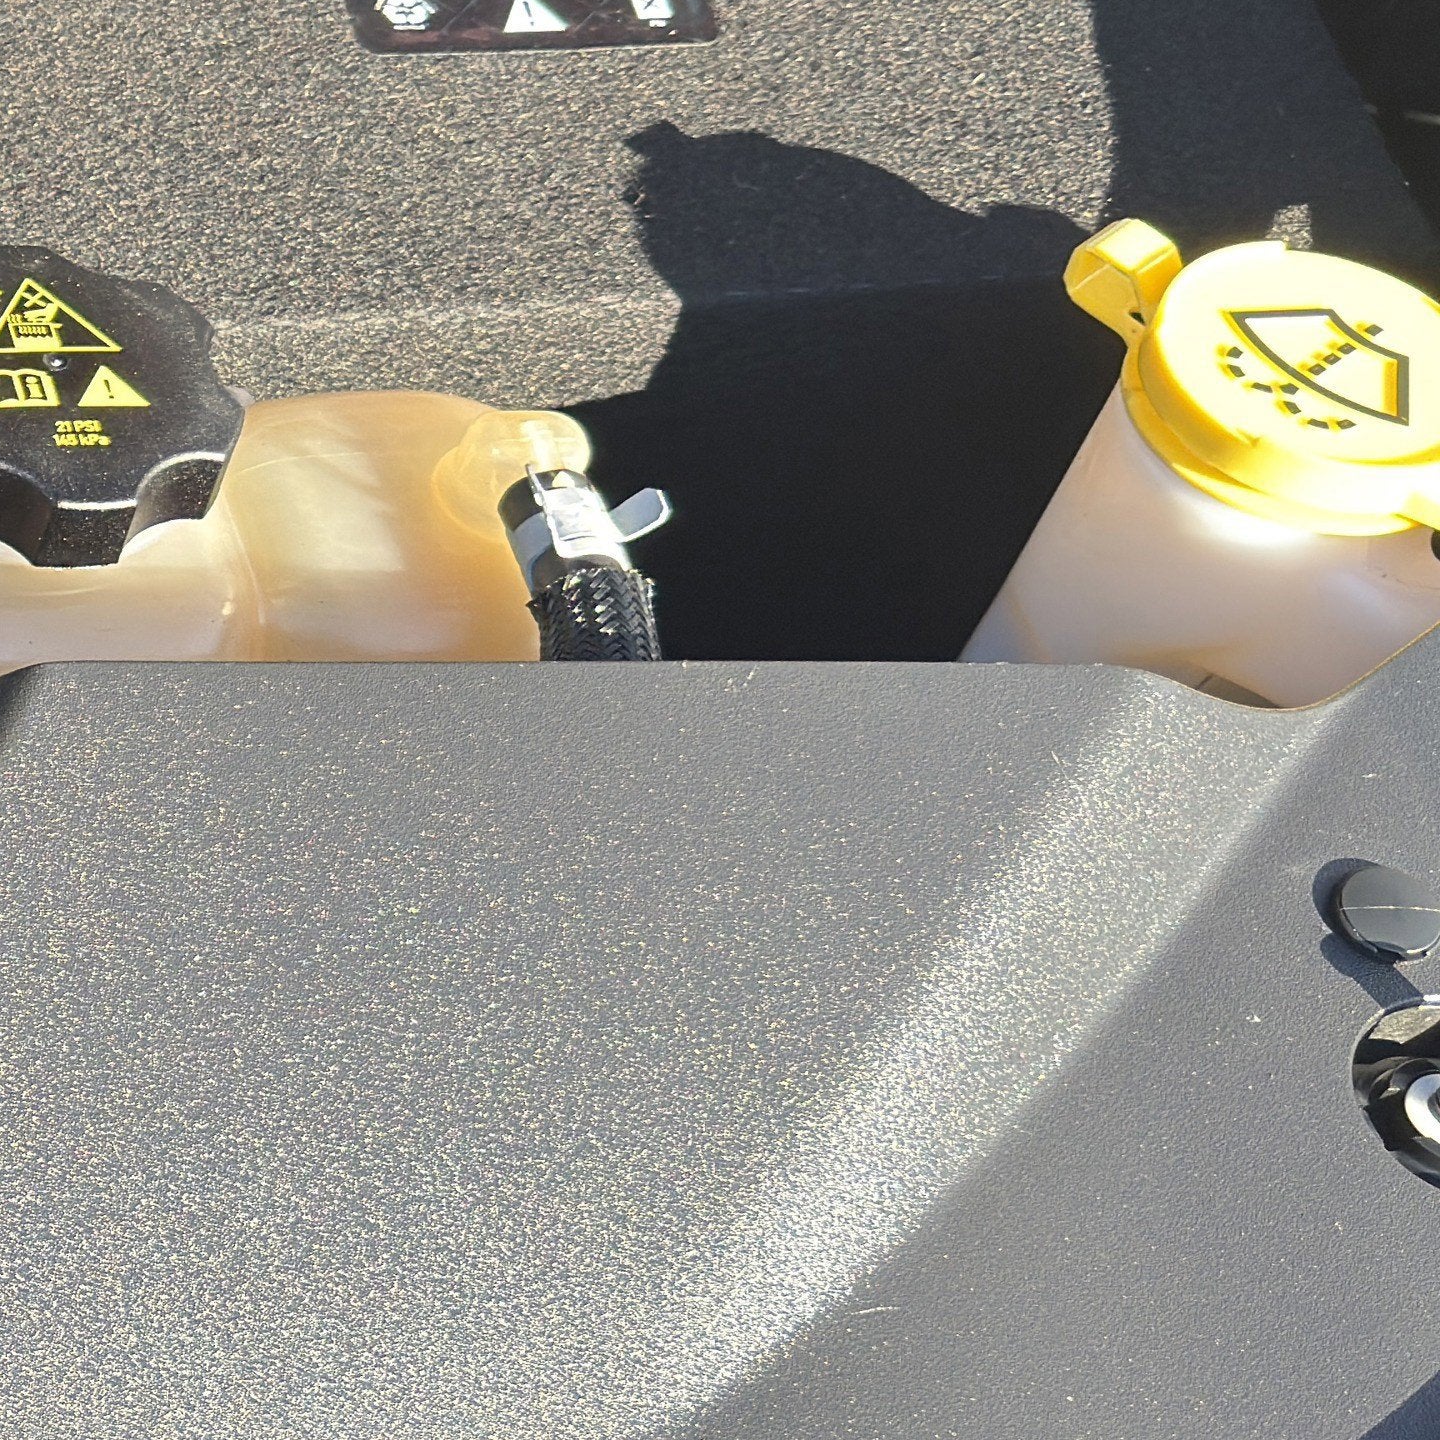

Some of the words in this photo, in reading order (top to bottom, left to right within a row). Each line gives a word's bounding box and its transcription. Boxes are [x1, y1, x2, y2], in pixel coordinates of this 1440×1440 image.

[54, 420, 72, 433] 21
[73, 419, 103, 433] PSI
[52, 433, 79, 447] 145
[79, 433, 112, 446] kPa
